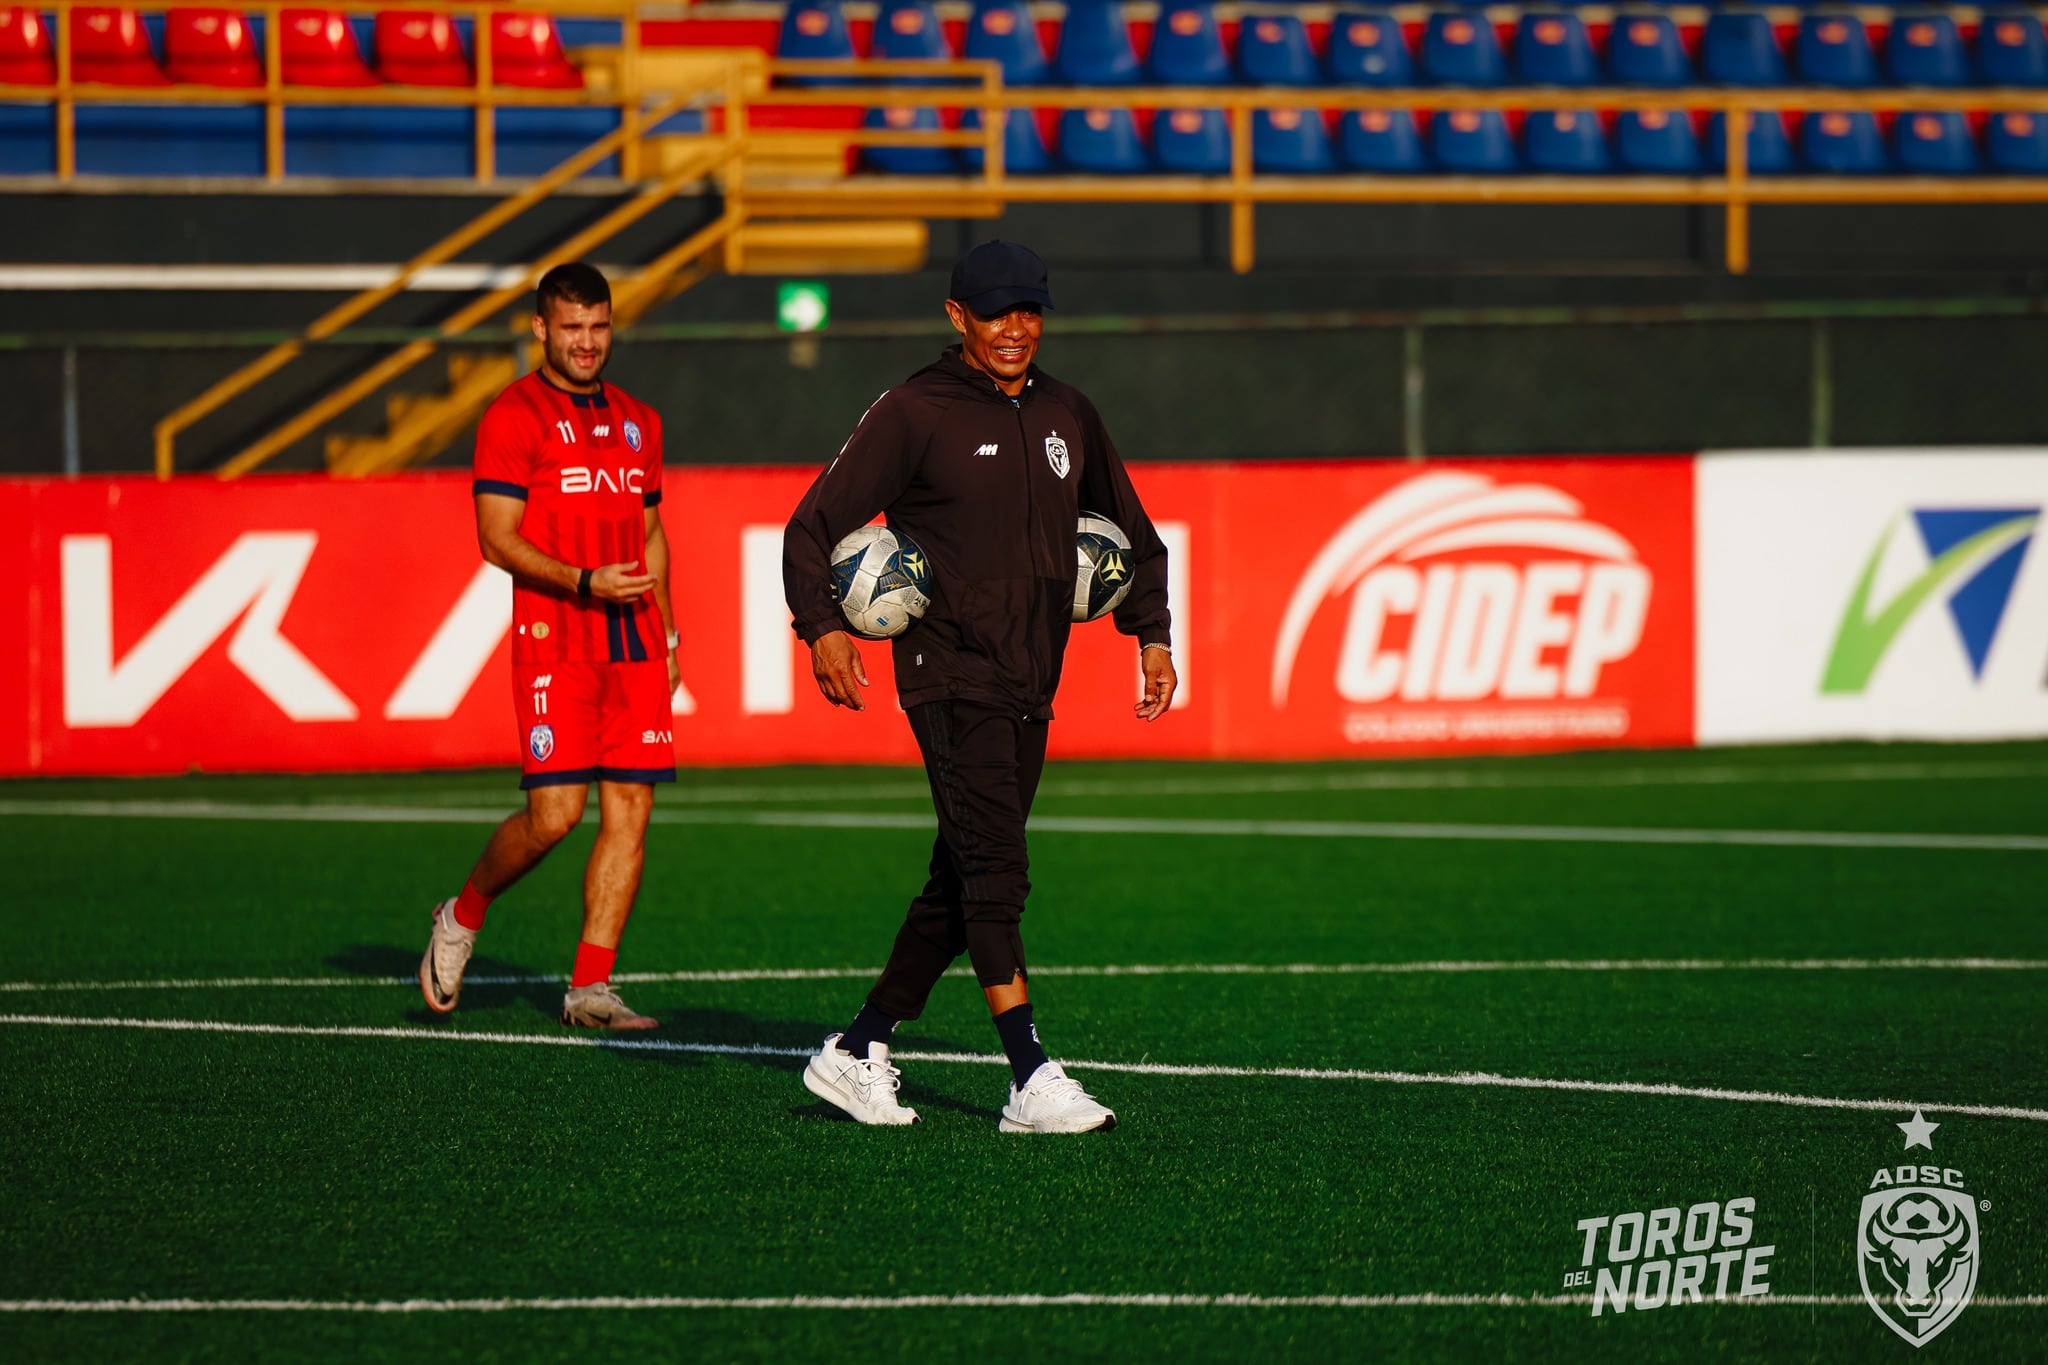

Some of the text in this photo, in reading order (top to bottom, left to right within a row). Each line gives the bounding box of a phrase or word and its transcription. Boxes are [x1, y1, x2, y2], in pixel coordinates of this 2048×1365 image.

[556, 420, 577, 445] 11
[560, 466, 645, 494] BAIC
[1334, 562, 1652, 703] CIDEP
[533, 689, 549, 715] 11
